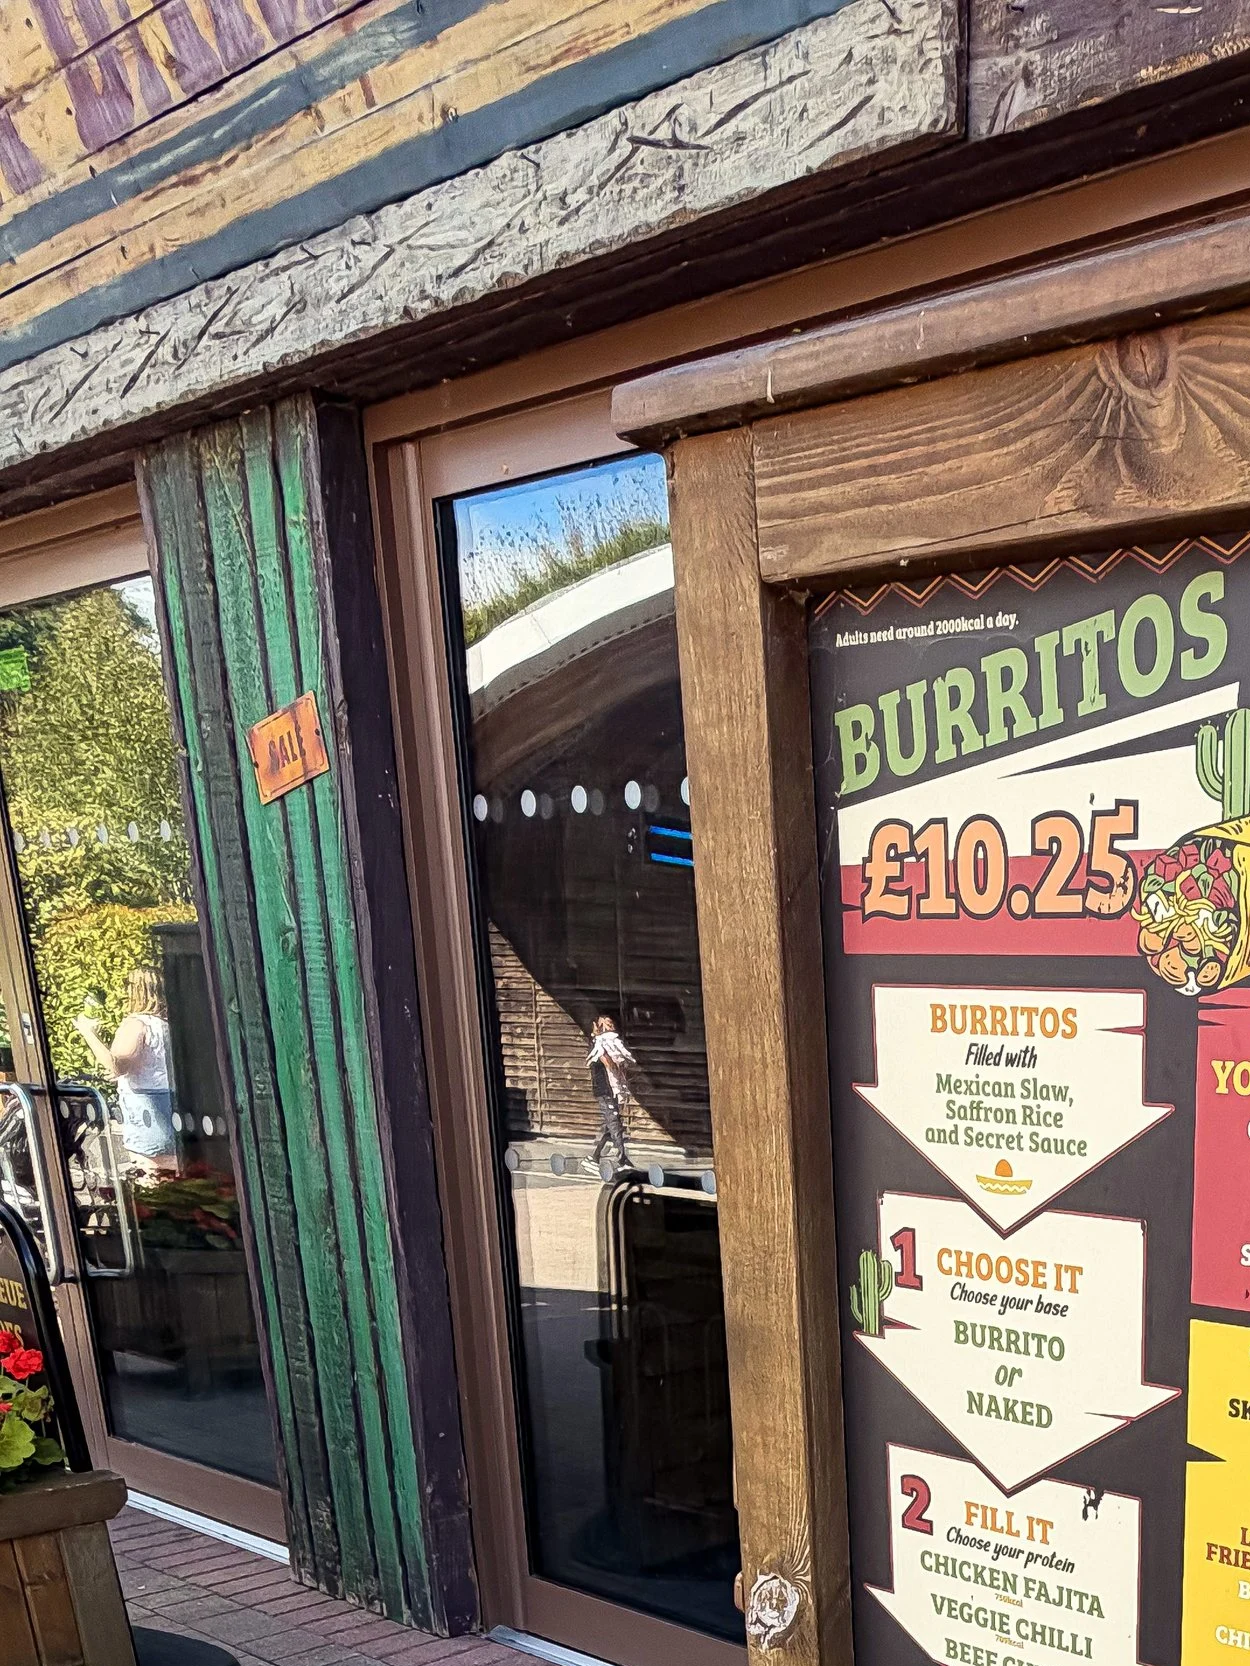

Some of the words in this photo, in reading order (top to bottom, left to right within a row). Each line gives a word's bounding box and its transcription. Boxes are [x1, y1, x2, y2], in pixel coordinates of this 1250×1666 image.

[836, 632, 868, 647] Adults
[870, 627, 894, 643] need
[896, 621, 934, 639] around
[936, 615, 984, 634] 2000kcal
[987, 619, 993, 629] a
[995, 612, 1019, 630] day.
[834, 571, 1228, 795] BURRITOS
[862, 800, 1140, 920] £10.25
[930, 1004, 1077, 1038] BURRITOS
[965, 1043, 1001, 1067] Filled
[1005, 1046, 1037, 1068] with
[936, 1073, 1015, 1098] Mexican
[1020, 1078, 1074, 1106] Slaw,
[946, 1100, 1017, 1124] Saffron
[1022, 1105, 1063, 1128] Rice
[925, 1126, 959, 1145] and
[964, 1127, 1024, 1152] Secret
[1029, 1132, 1087, 1156] Sauce
[937, 1248, 1046, 1289] CHOOSE
[1054, 1263, 1083, 1294] IT
[950, 1282, 997, 1306] Choose
[999, 1295, 1033, 1315] your
[1035, 1295, 1068, 1317] base
[954, 1320, 1065, 1361] BURRITO
[995, 1365, 1022, 1387] or
[967, 1390, 1052, 1428] NAKED
[964, 1501, 1020, 1537] FILL
[1026, 1515, 1053, 1544] IT
[947, 1526, 991, 1552] Choose
[992, 1541, 1024, 1561] your
[1024, 1551, 1075, 1574] protein
[920, 1550, 1018, 1595] CHICKEN
[1023, 1577, 1105, 1619] FAJITA
[931, 1593, 1010, 1635] VEGGIE
[1016, 1619, 1092, 1659] CHILLI
